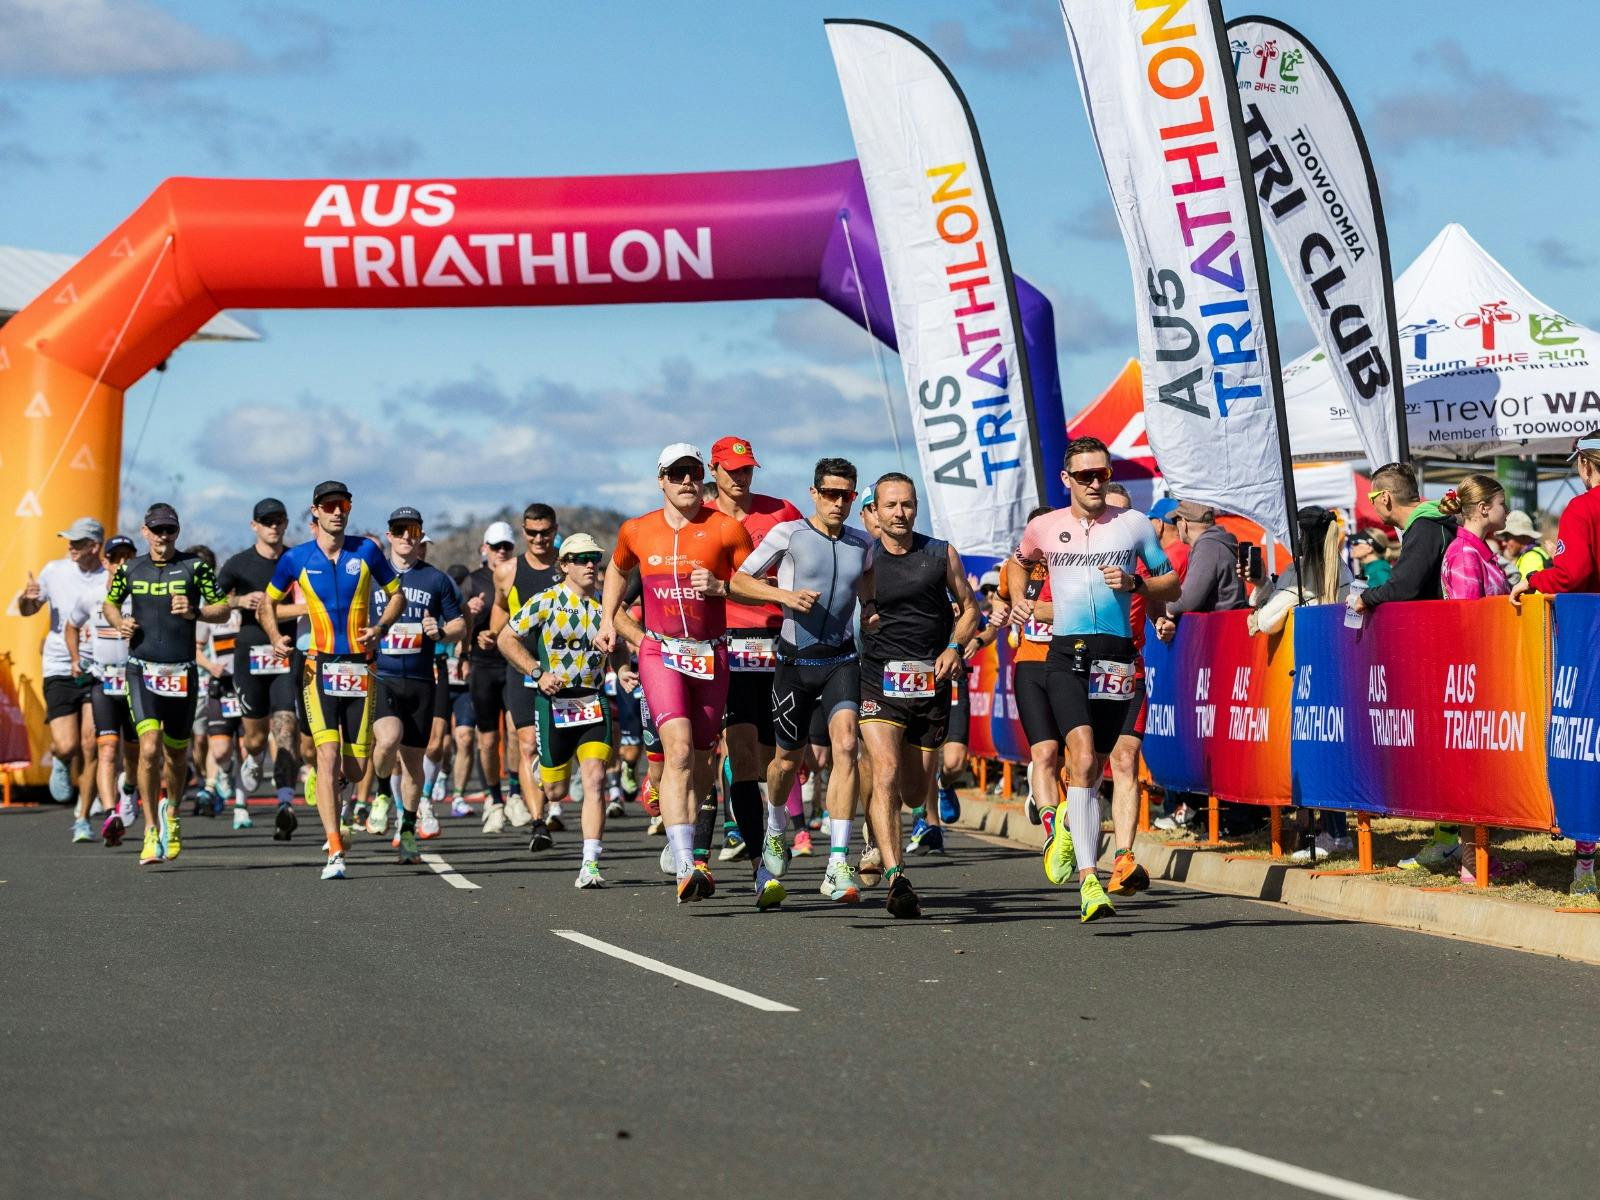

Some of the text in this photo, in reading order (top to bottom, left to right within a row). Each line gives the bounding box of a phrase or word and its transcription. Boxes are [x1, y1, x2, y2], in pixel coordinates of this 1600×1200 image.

[304, 184, 457, 227] AUS
[1134, 0, 1262, 417] TRIATHLON
[1291, 128, 1366, 263] TOOWOOMBA
[304, 227, 714, 288] TRIATHLON
[1244, 103, 1307, 218] TRI
[1300, 232, 1391, 400] CLUB
[926, 162, 1020, 486] TRIATHLON
[1148, 267, 1211, 419] AUS
[1406, 349, 1585, 374] SWIM BIKE RUN
[1407, 360, 1590, 380] TOOWOOMBA TRI CLUB
[1425, 395, 1533, 423] Trevor
[919, 375, 978, 489] AUS
[1429, 427, 1486, 442] Member
[1491, 425, 1509, 437] for
[385, 634, 417, 649] 177
[735, 652, 773, 667] 157
[328, 675, 362, 691] 152
[668, 656, 707, 674] 153
[890, 672, 928, 692] 143
[1095, 673, 1133, 694] 156
[1296, 664, 1312, 700] AUS
[1368, 665, 1387, 702] AUS
[149, 676, 181, 692] 135
[1443, 664, 1477, 704] AUS
[1292, 705, 1345, 743] TRIATHLON
[1369, 708, 1415, 748] TRIATHLON
[1443, 710, 1527, 752] TRIATHLON
